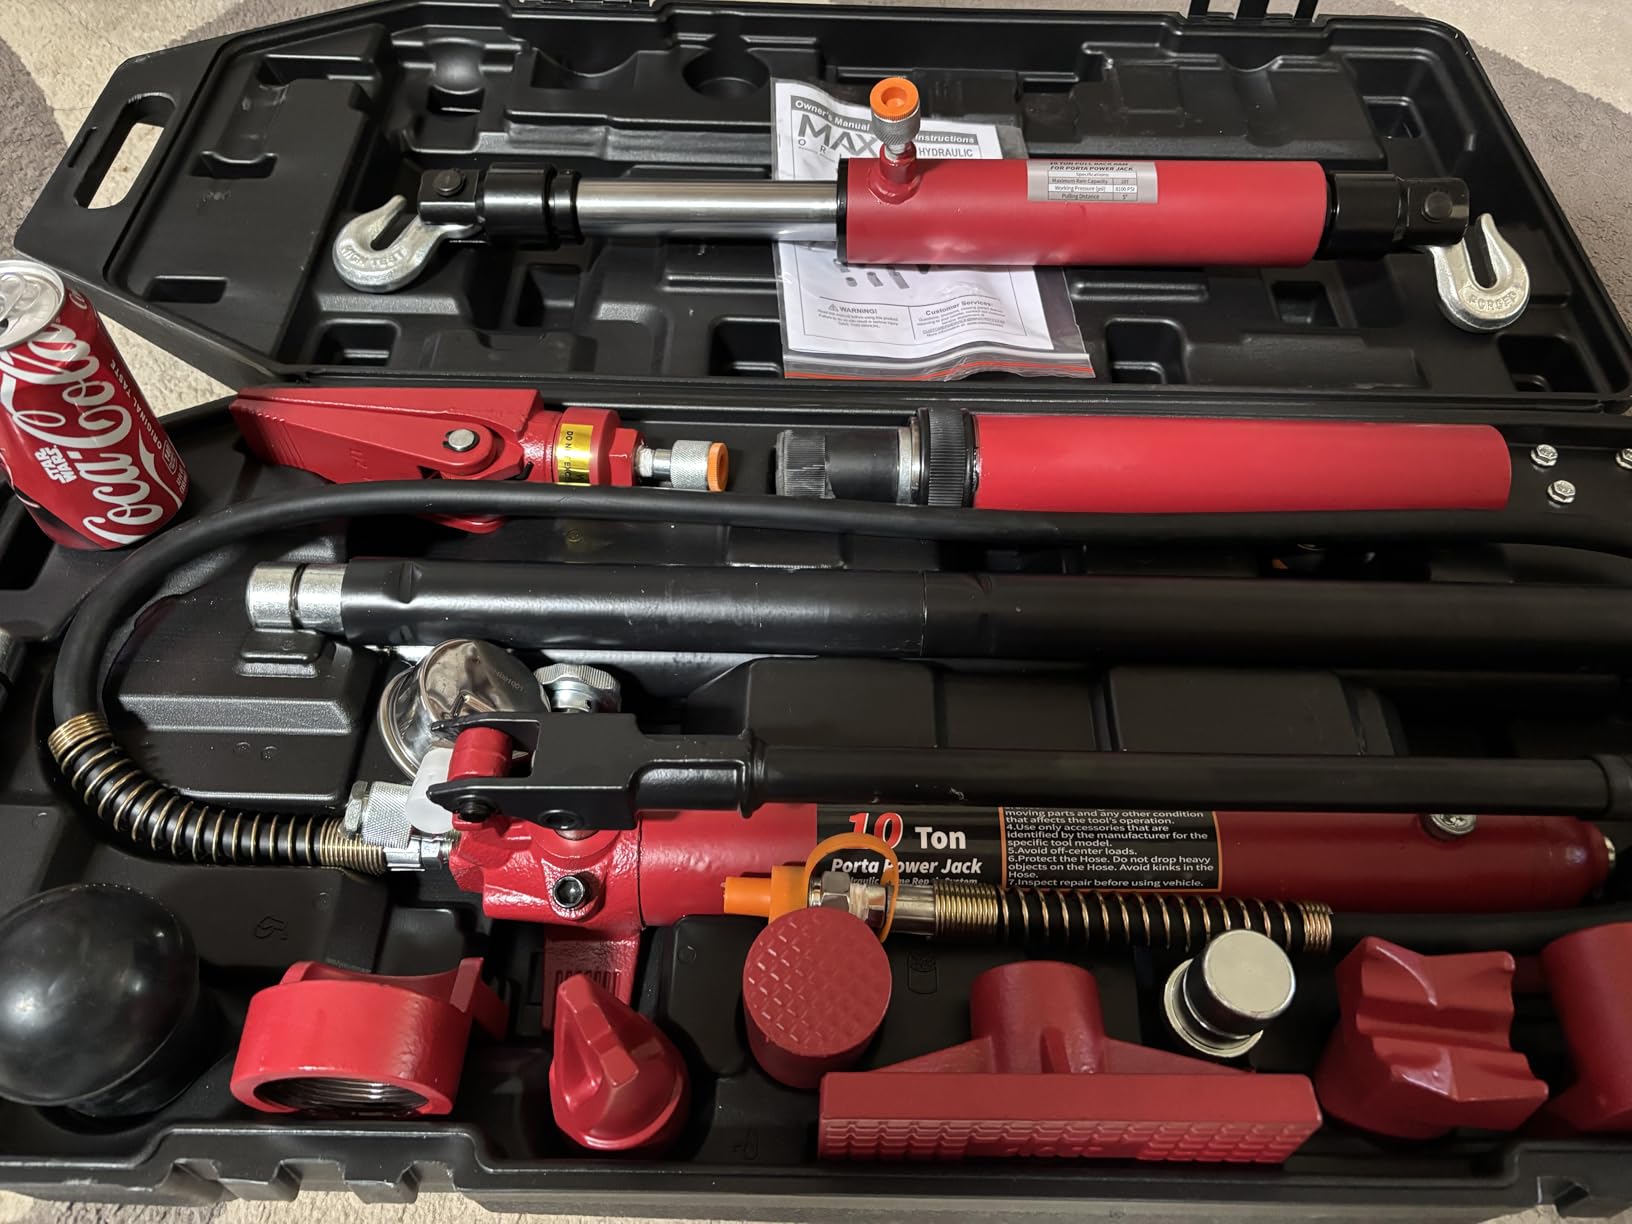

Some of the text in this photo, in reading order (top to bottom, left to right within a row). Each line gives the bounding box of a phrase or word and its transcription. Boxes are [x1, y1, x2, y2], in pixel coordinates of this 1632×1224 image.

[795, 100, 833, 122] Owner's
[834, 116, 871, 131] Manual
[918, 148, 973, 158] HYDRAULIC
[1468, 290, 1518, 311] FORGED
[839, 306, 877, 315] WARNING!
[925, 303, 961, 316] Customer
[109, 359, 162, 449] ORIGINAL TASTE
[0, 322, 164, 544] Coca-Cola
[34, 446, 67, 484] STAR
[1119, 817, 1175, 826] operation.
[849, 812, 966, 850] 10 Ton
[1038, 824, 1062, 832] only
[1007, 831, 1059, 839] identified
[1061, 831, 1075, 840] by
[1076, 831, 1095, 839] the
[1097, 832, 1171, 840] manufacturer
[1190, 832, 1208, 840] the
[1007, 839, 1113, 847] specific tool model.
[1008, 855, 1211, 865] 6.Protect the Hose. Do not drop heavy
[832, 858, 879, 873] Porta
[941, 858, 982, 874] Jack
[1008, 863, 1214, 871] objects on the Hose. Avoid kinks in the
[1008, 871, 1039, 879] Hose.
[1009, 879, 1204, 888] 7.Inspect repair before using vehicle.
